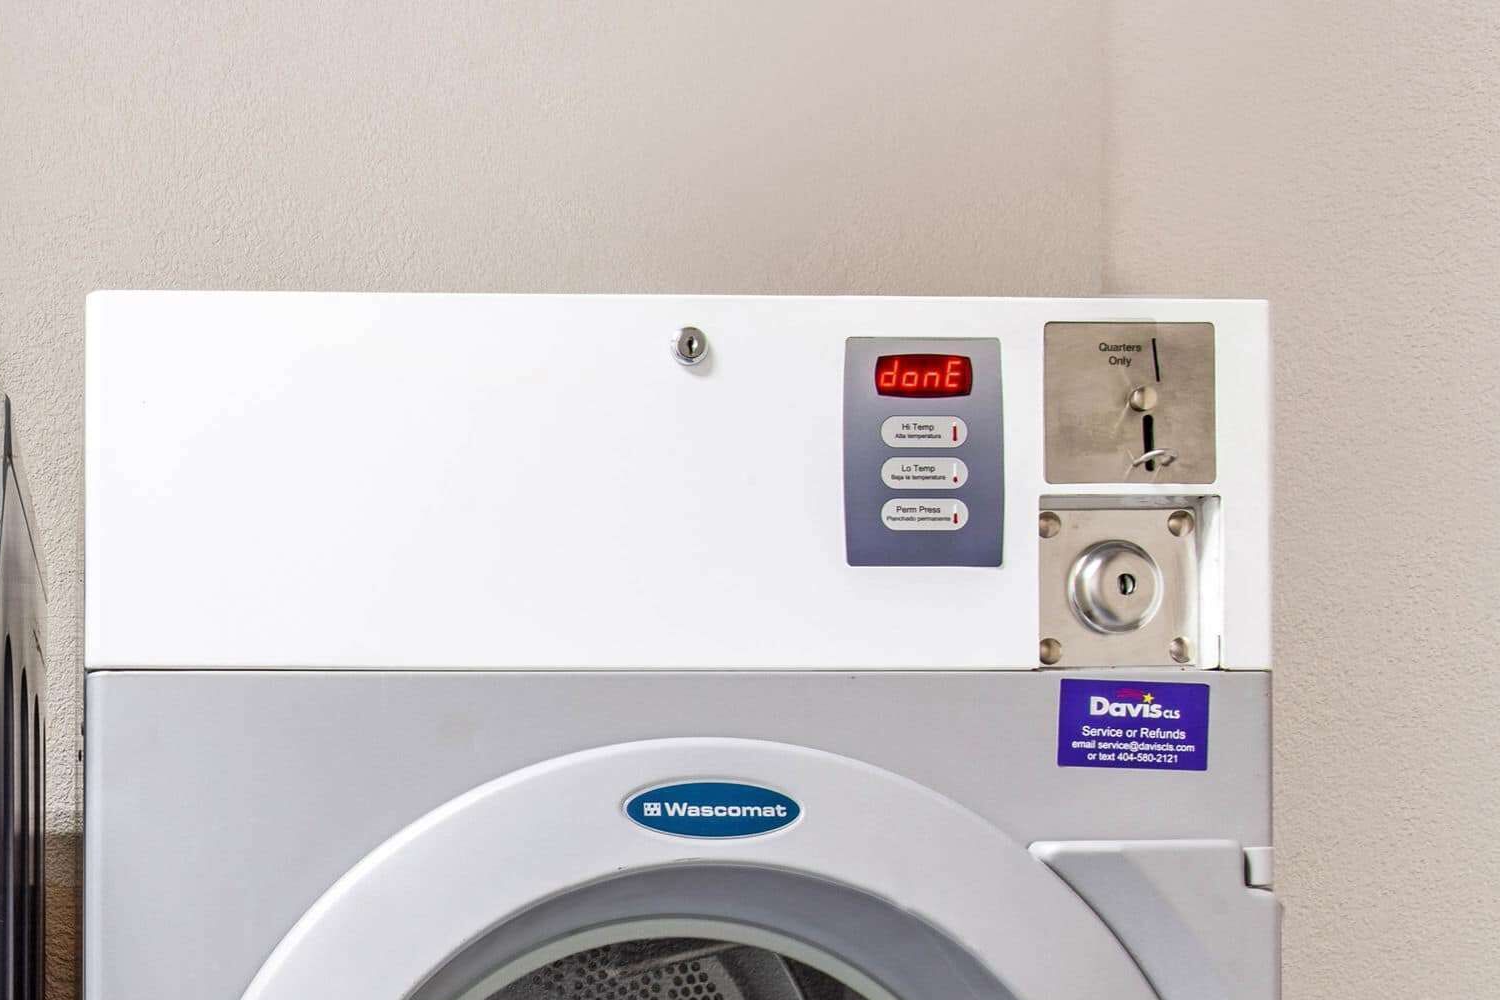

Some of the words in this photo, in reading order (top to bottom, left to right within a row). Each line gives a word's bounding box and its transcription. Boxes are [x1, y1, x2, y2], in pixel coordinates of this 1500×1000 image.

[1098, 343, 1142, 352] Quarters
[1109, 356, 1132, 367] Only
[880, 360, 961, 387] donE
[913, 424, 934, 432] Temp
[914, 465, 935, 473] Temp
[1090, 696, 1162, 718] Davis
[1163, 709, 1180, 719] CLS
[1082, 726, 1123, 738] Service
[1126, 729, 1137, 738] or
[1140, 728, 1186, 739] Refunds
[1072, 740, 1095, 748] email
[1098, 741, 1195, 752] service@daviscls.com
[1099, 752, 1115, 761] text
[1117, 753, 1178, 763] 404-580-2121
[664, 802, 787, 817] Wascomat
